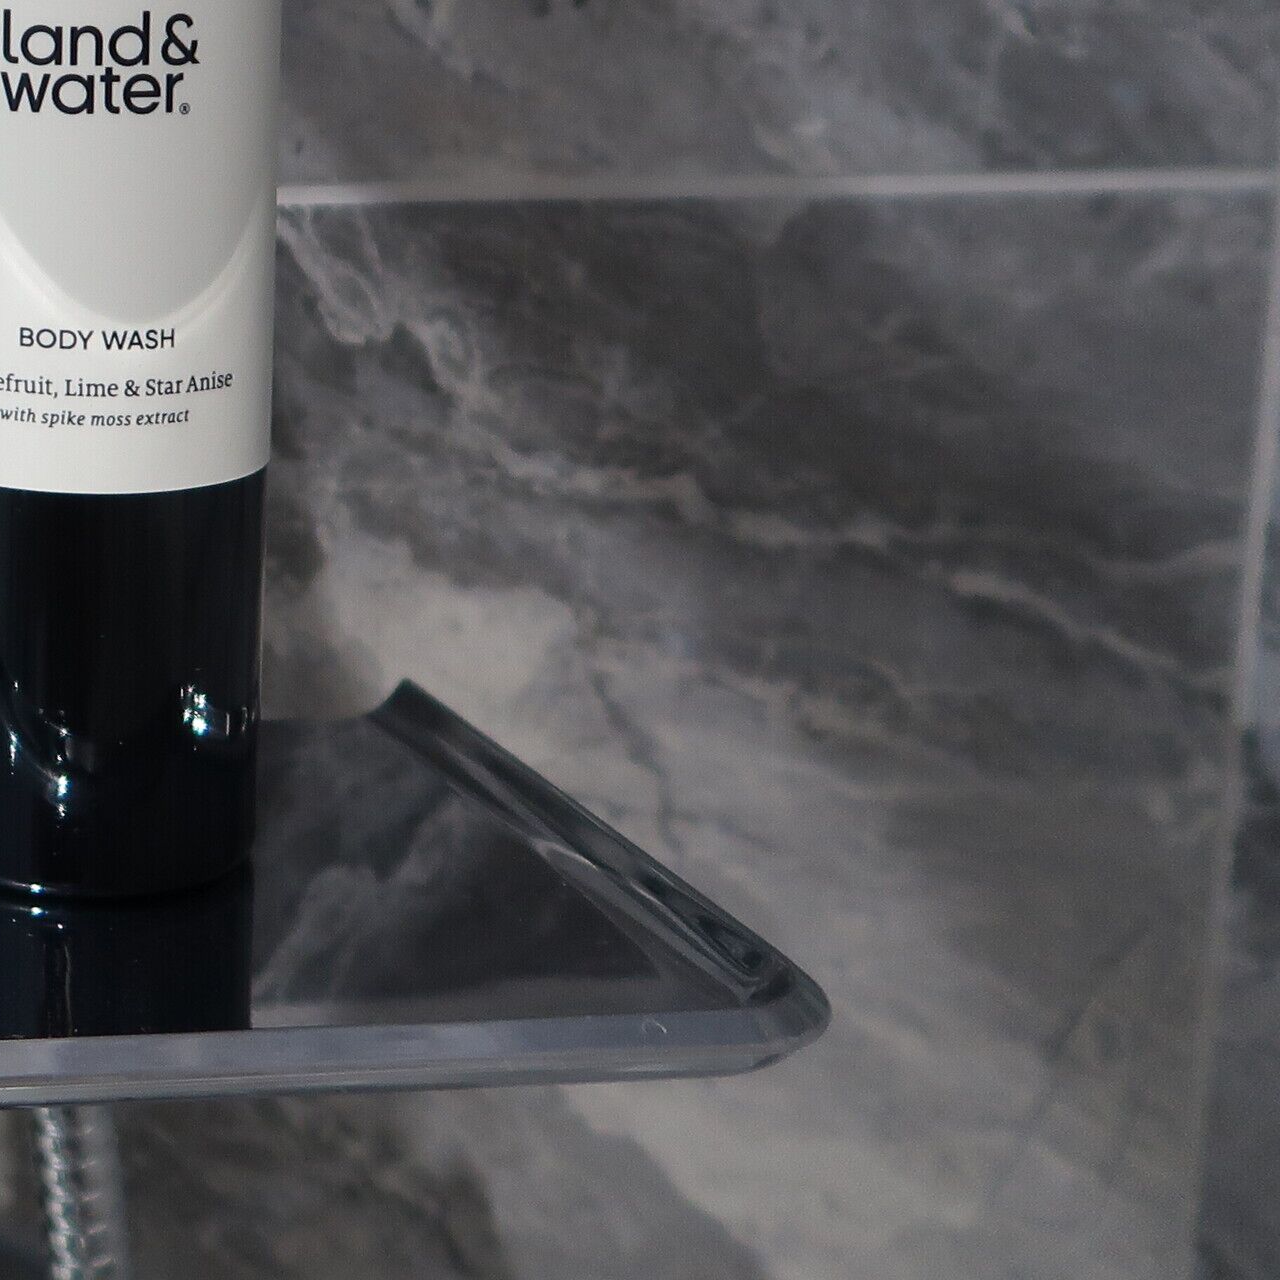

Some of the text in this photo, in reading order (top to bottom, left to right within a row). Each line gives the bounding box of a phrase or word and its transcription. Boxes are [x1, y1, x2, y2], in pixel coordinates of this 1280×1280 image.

[19, 326, 176, 350] BODY WASH
[64, 378, 119, 398] Lime
[124, 379, 141, 398] &
[145, 377, 183, 396] Star
[186, 370, 234, 394] Anise
[0, 406, 190, 429] with spike moss extract
